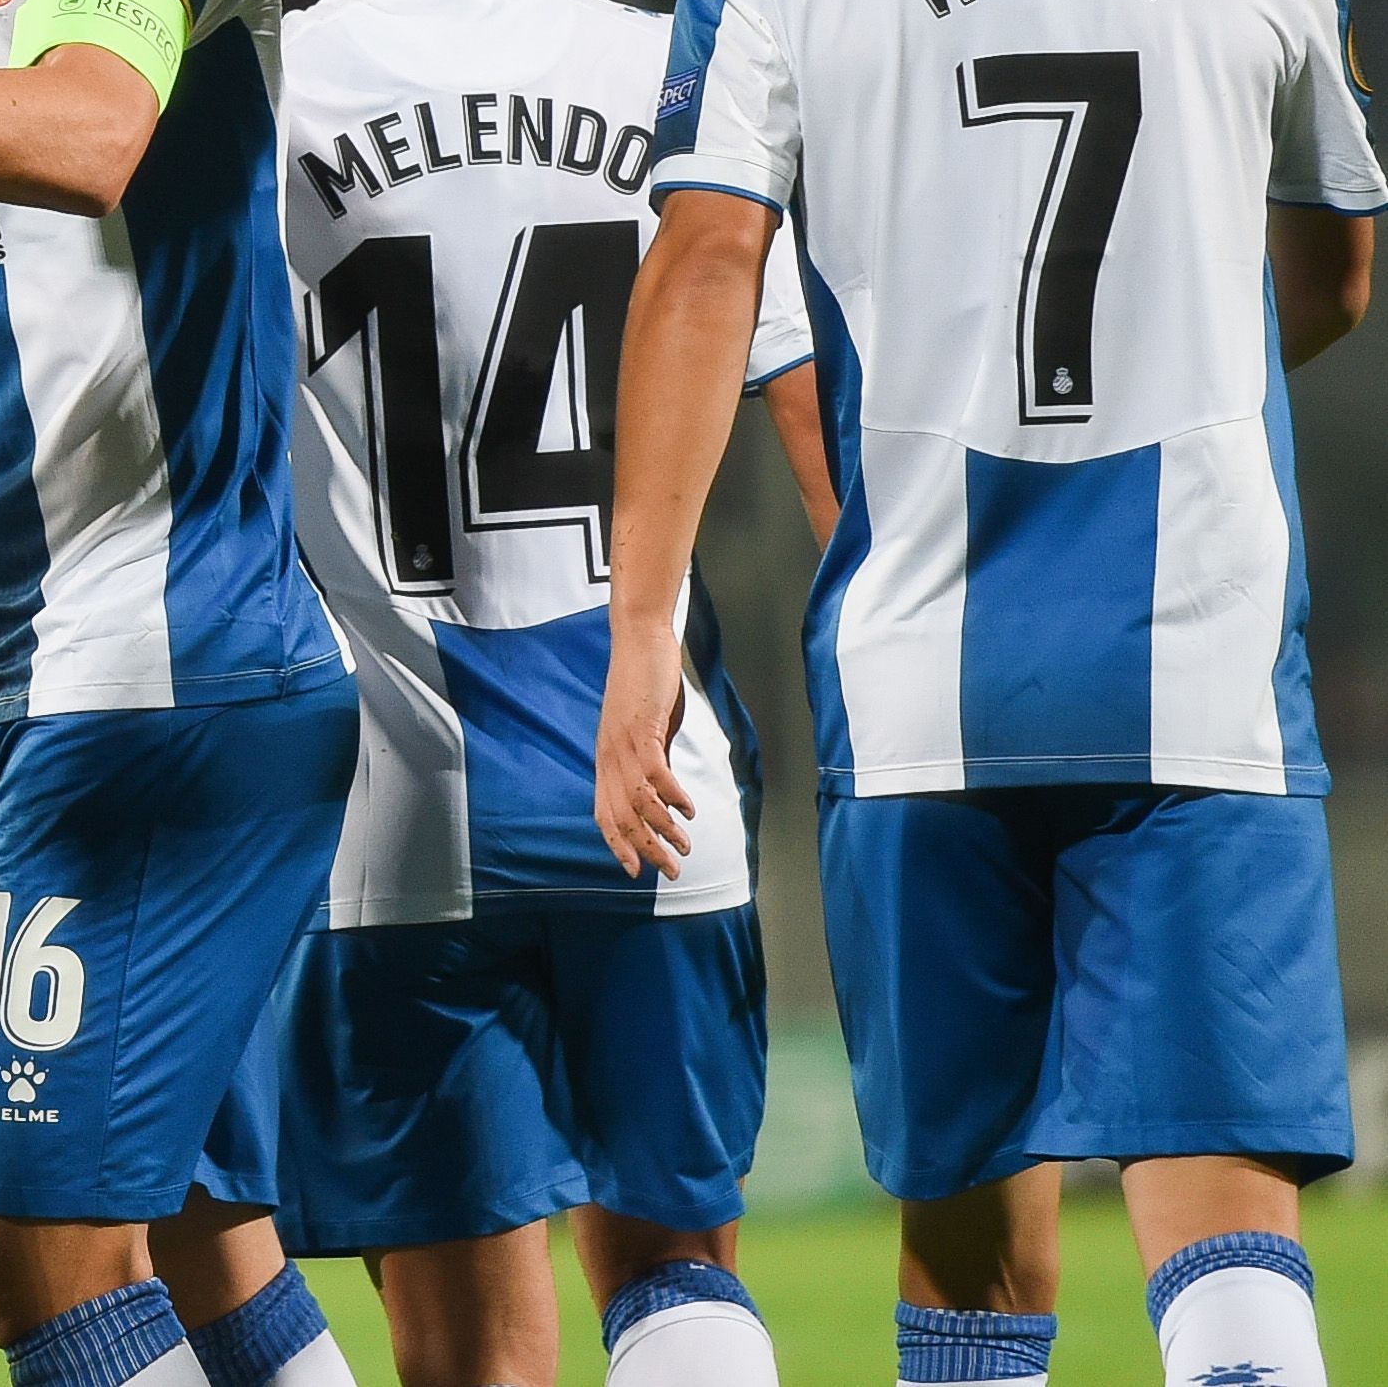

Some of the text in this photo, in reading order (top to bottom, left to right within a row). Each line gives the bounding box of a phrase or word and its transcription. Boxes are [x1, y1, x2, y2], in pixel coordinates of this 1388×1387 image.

[298, 93, 652, 220] MELENDO
[956, 51, 1142, 427] 7
[303, 220, 640, 597] 14
